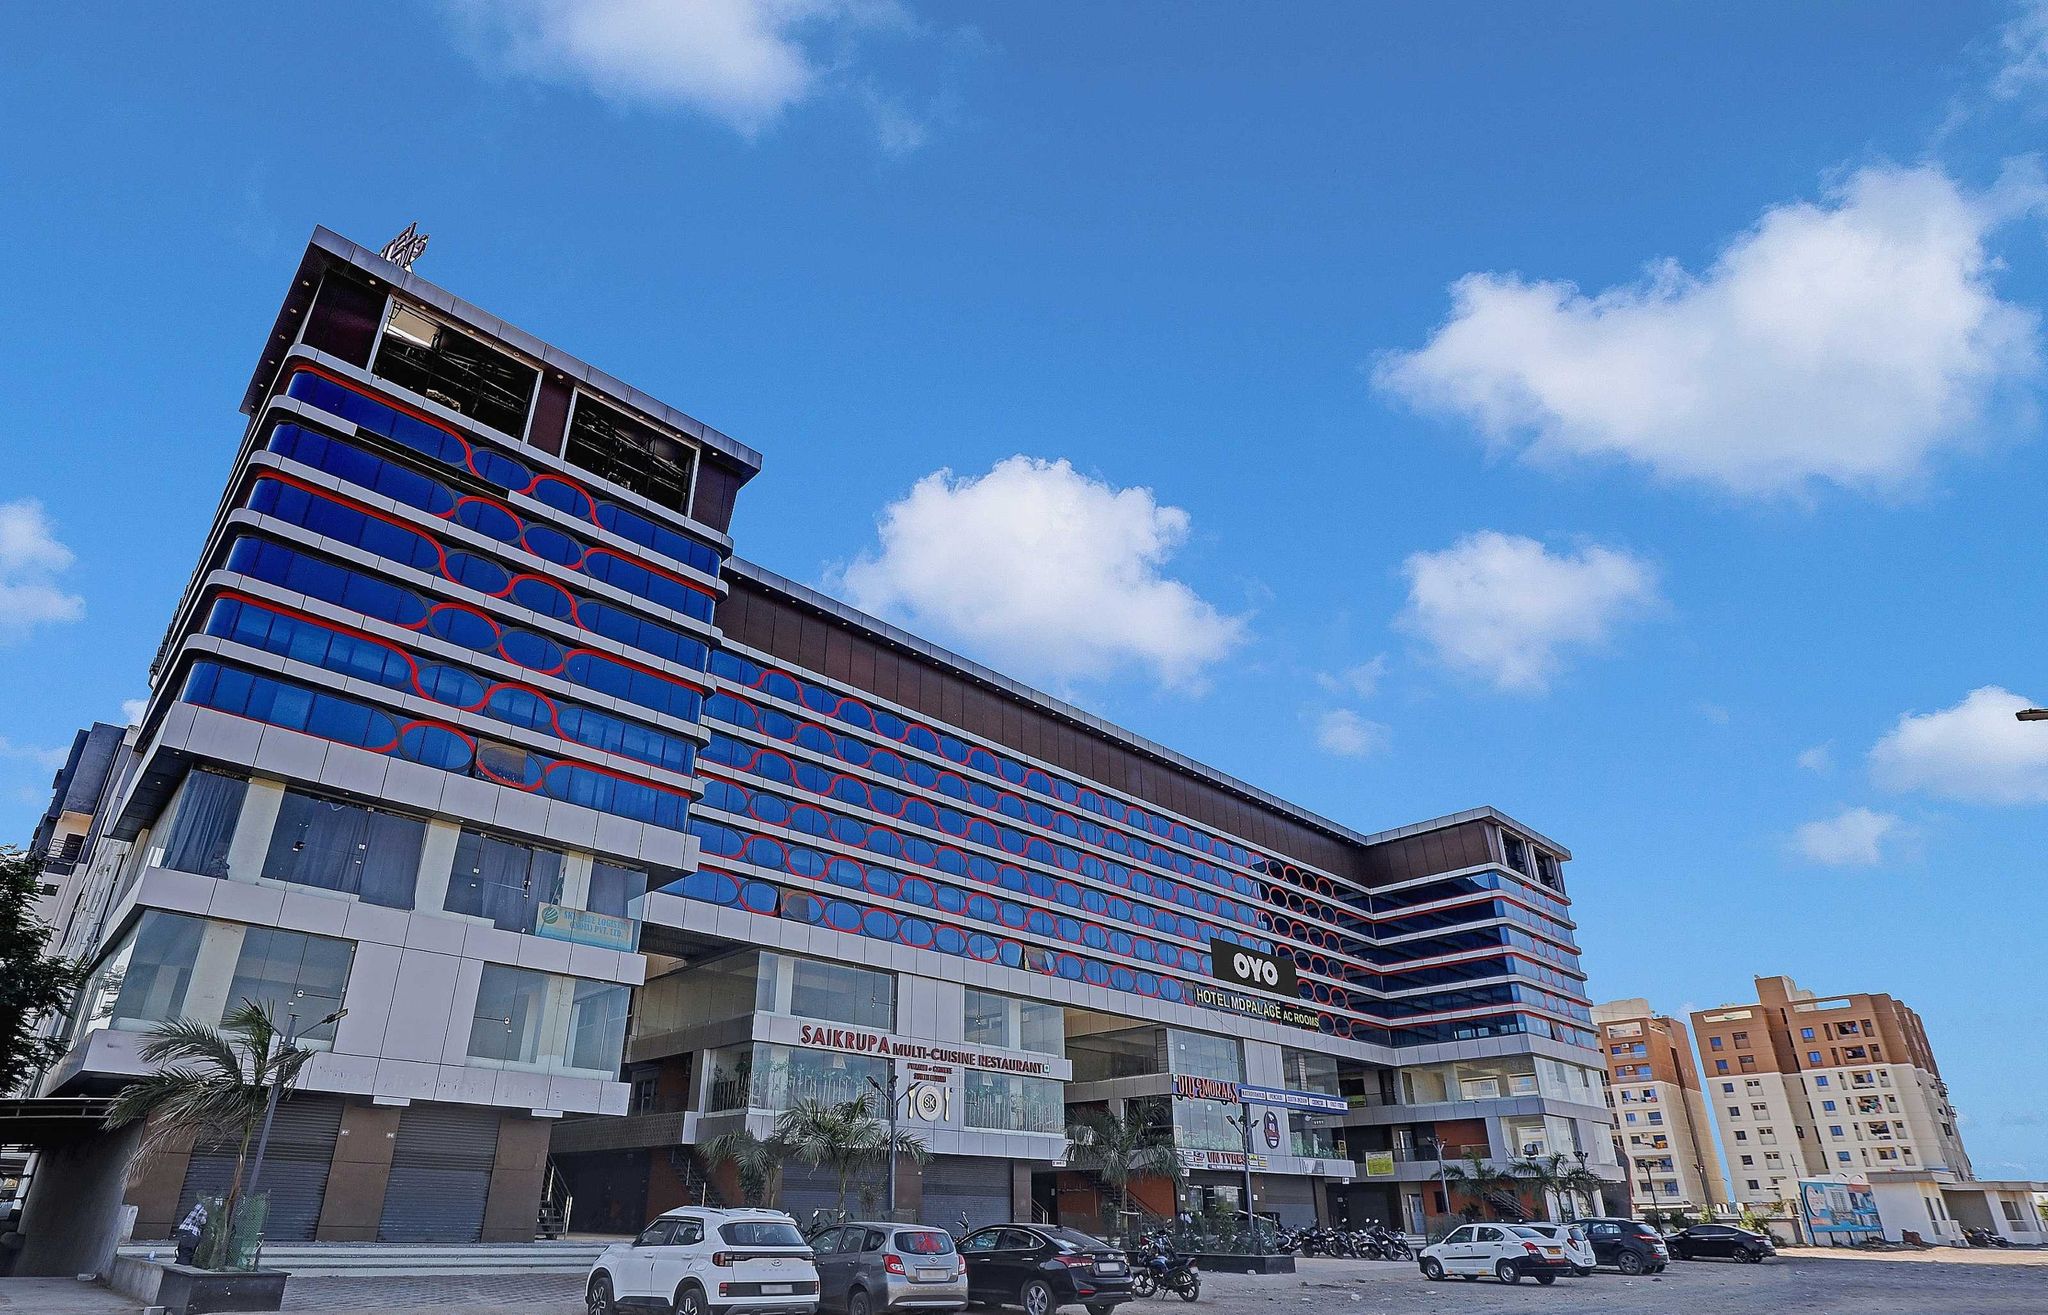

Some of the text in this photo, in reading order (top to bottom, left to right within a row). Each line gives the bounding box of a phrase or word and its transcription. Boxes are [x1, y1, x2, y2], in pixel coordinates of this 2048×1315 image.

[1233, 952, 1279, 986] OYO
[1196, 988, 1230, 1009] HOTEL
[1283, 1011, 1293, 1022] AC
[1293, 1012, 1320, 1027] ROOMS
[801, 1025, 1042, 1074] SAIKRUPA MULTI-CUISINE RESTAURANT
[924, 1098, 935, 1108] SK
